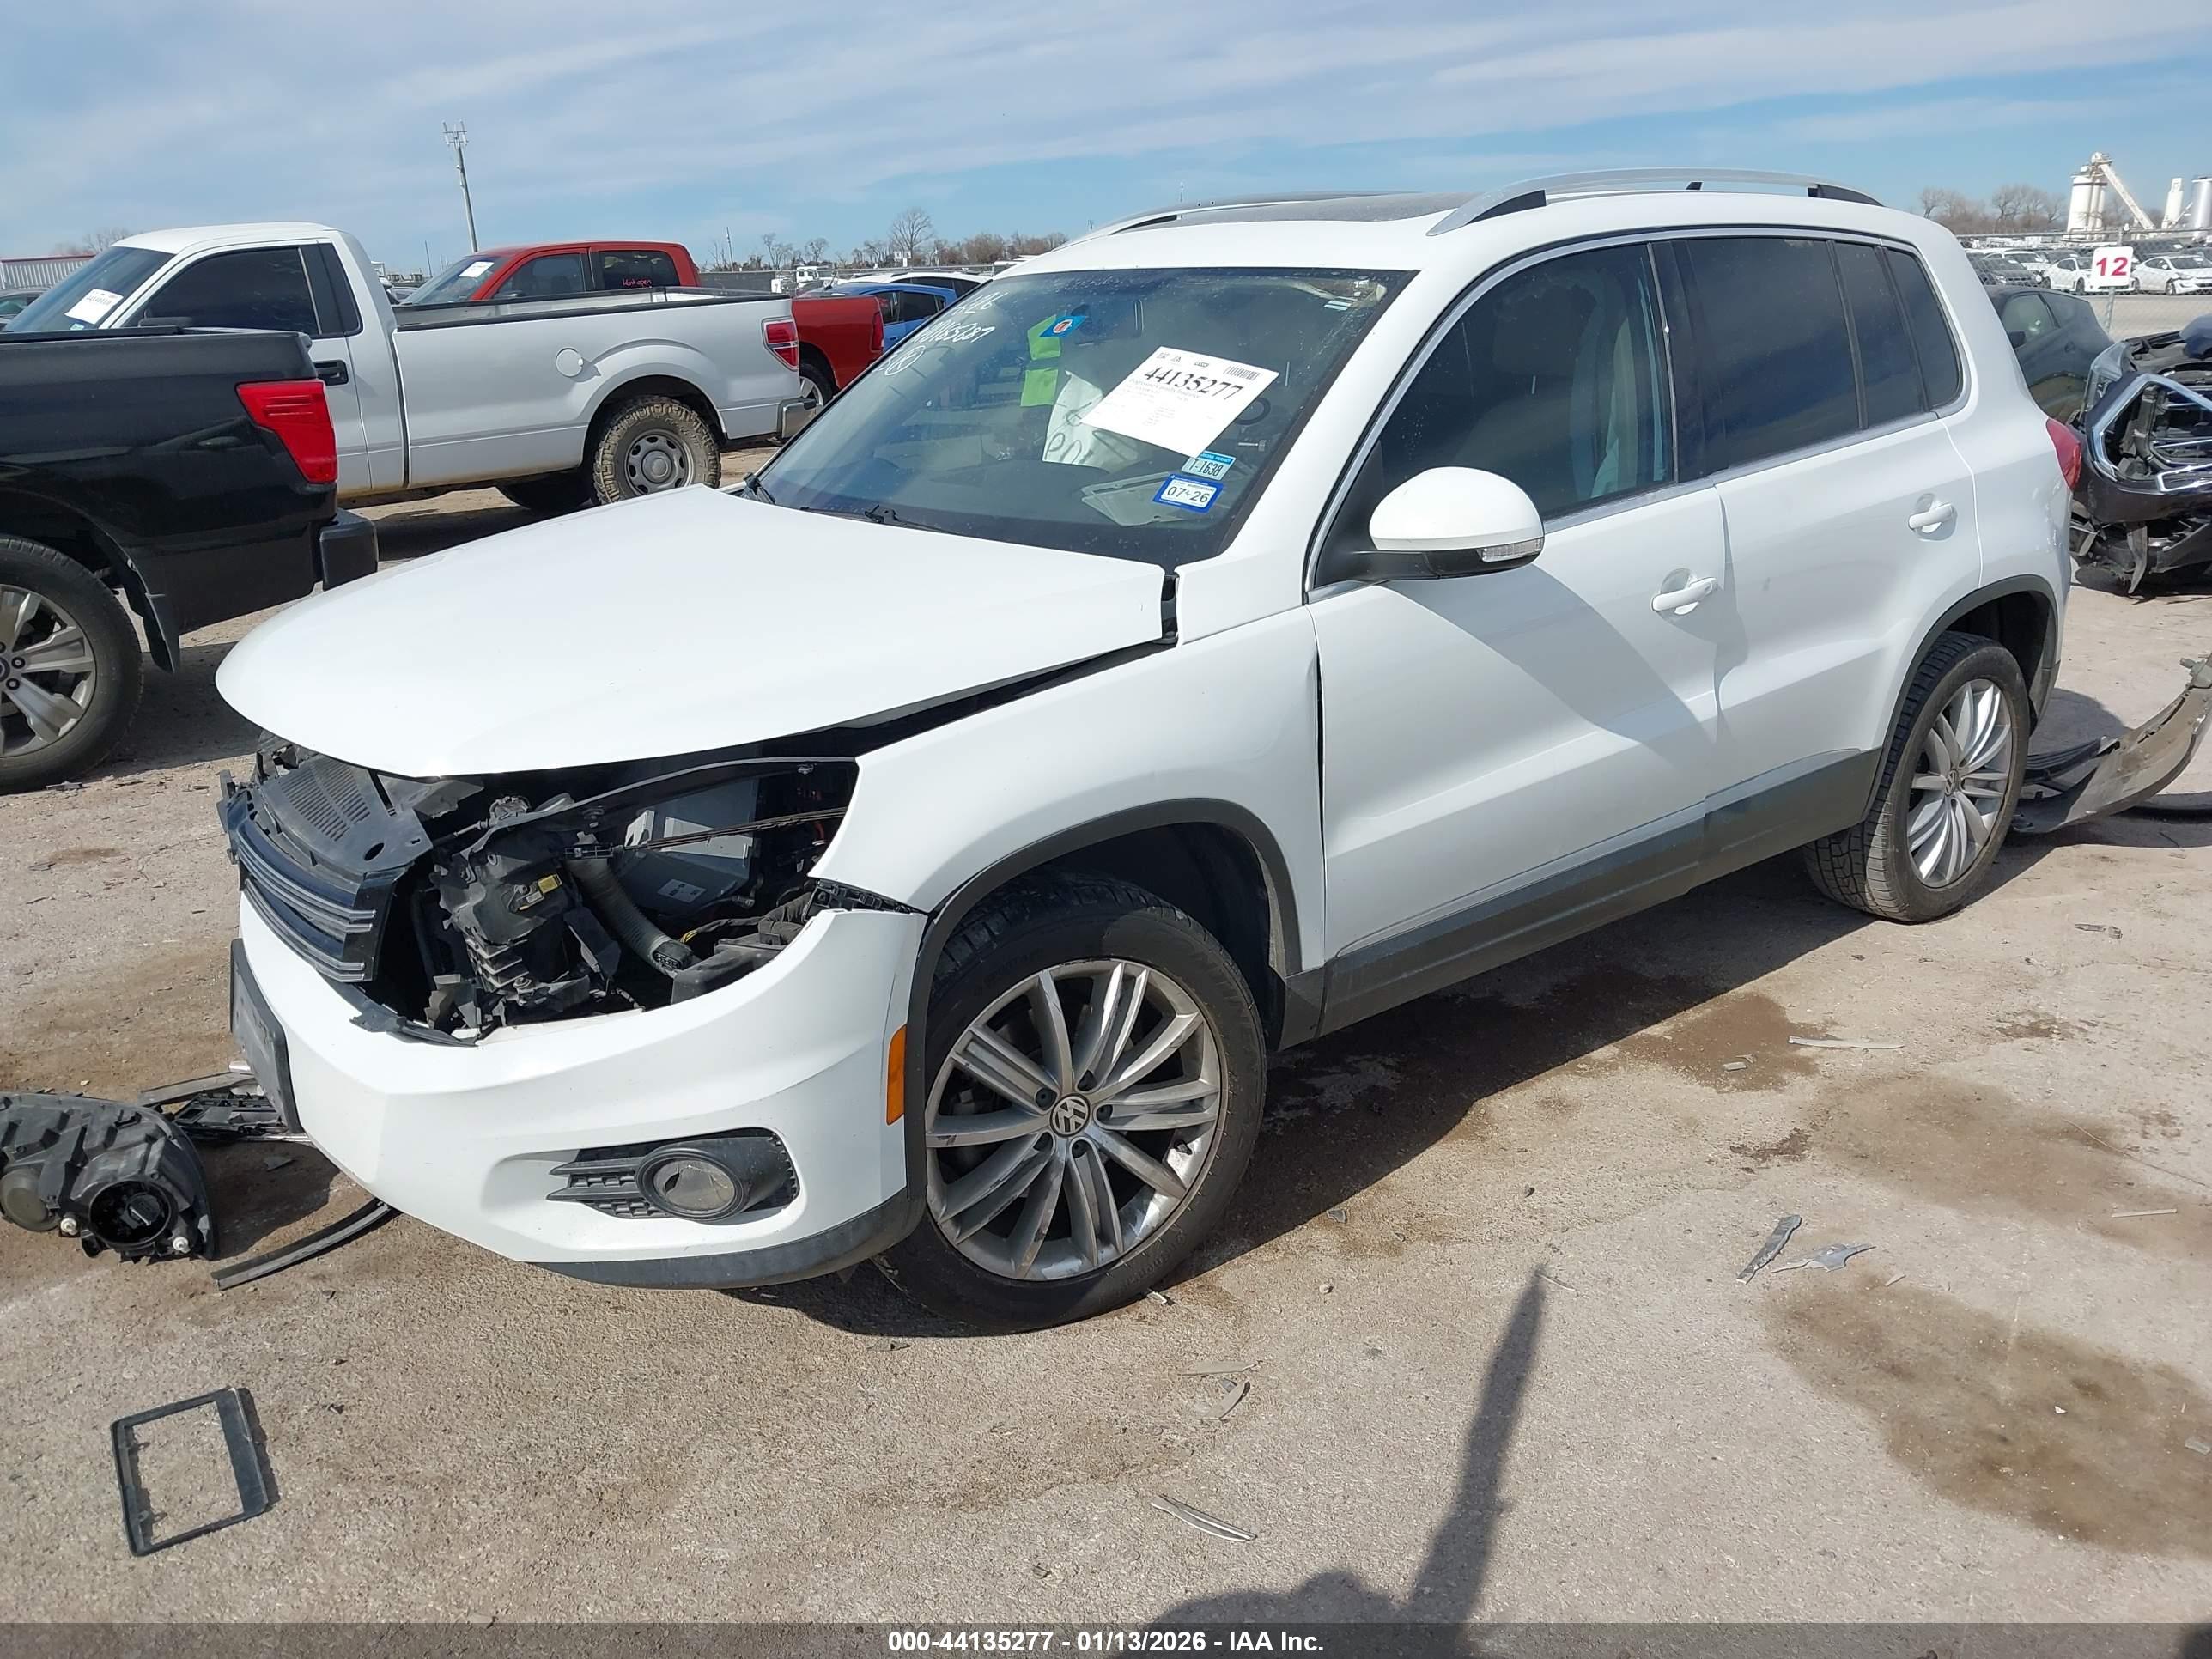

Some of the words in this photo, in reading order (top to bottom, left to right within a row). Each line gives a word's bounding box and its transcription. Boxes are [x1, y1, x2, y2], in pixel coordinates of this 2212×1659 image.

[2096, 257, 2128, 276] 12
[1144, 366, 1244, 400] 44135277
[1189, 459, 1224, 477] T-1638
